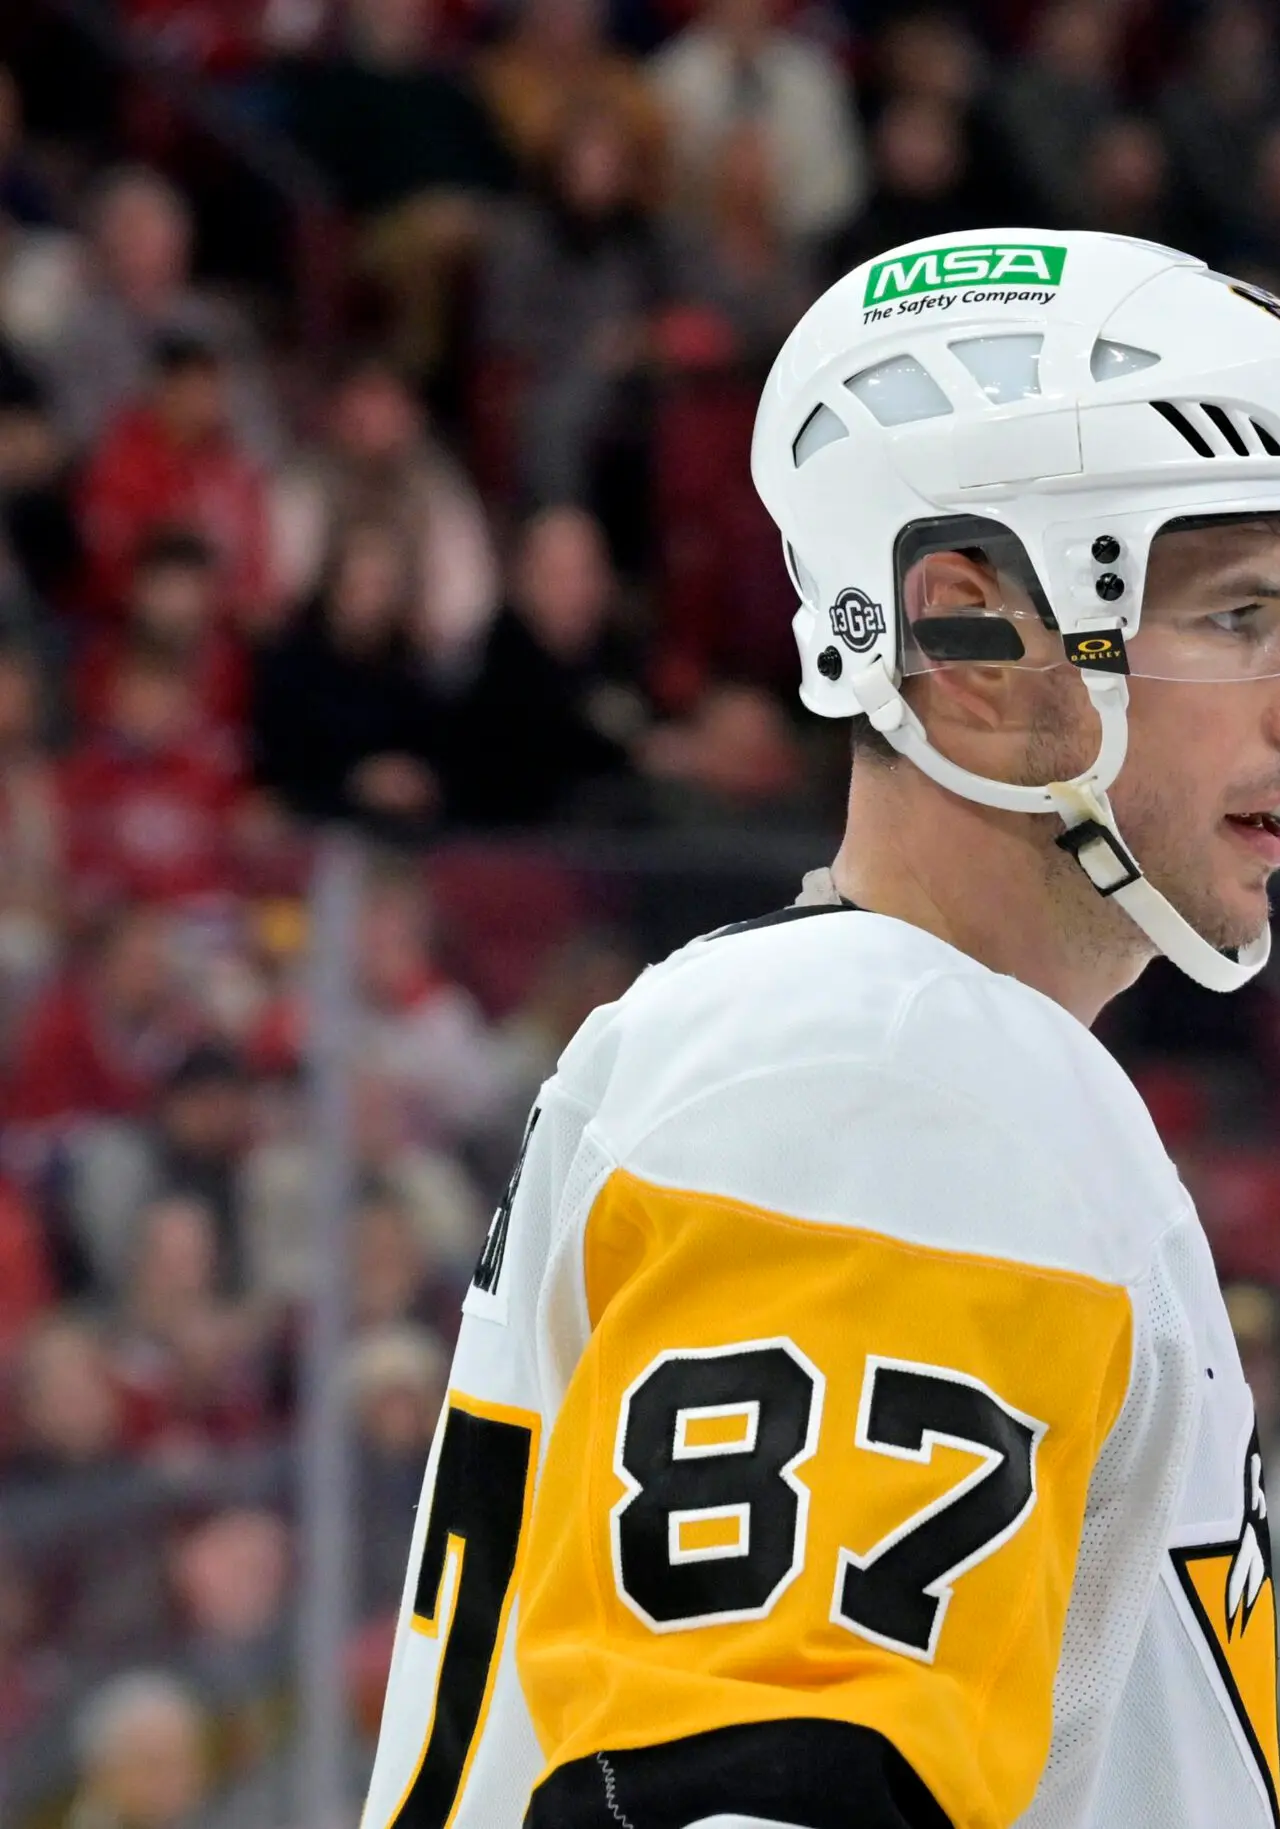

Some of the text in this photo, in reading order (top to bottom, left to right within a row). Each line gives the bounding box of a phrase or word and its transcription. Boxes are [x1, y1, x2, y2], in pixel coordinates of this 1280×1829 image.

[872, 248, 1051, 299] MSA
[863, 290, 1056, 325] The Safety Company
[1070, 650, 1121, 662] OAKLEY
[610, 1336, 1049, 1664] 87
